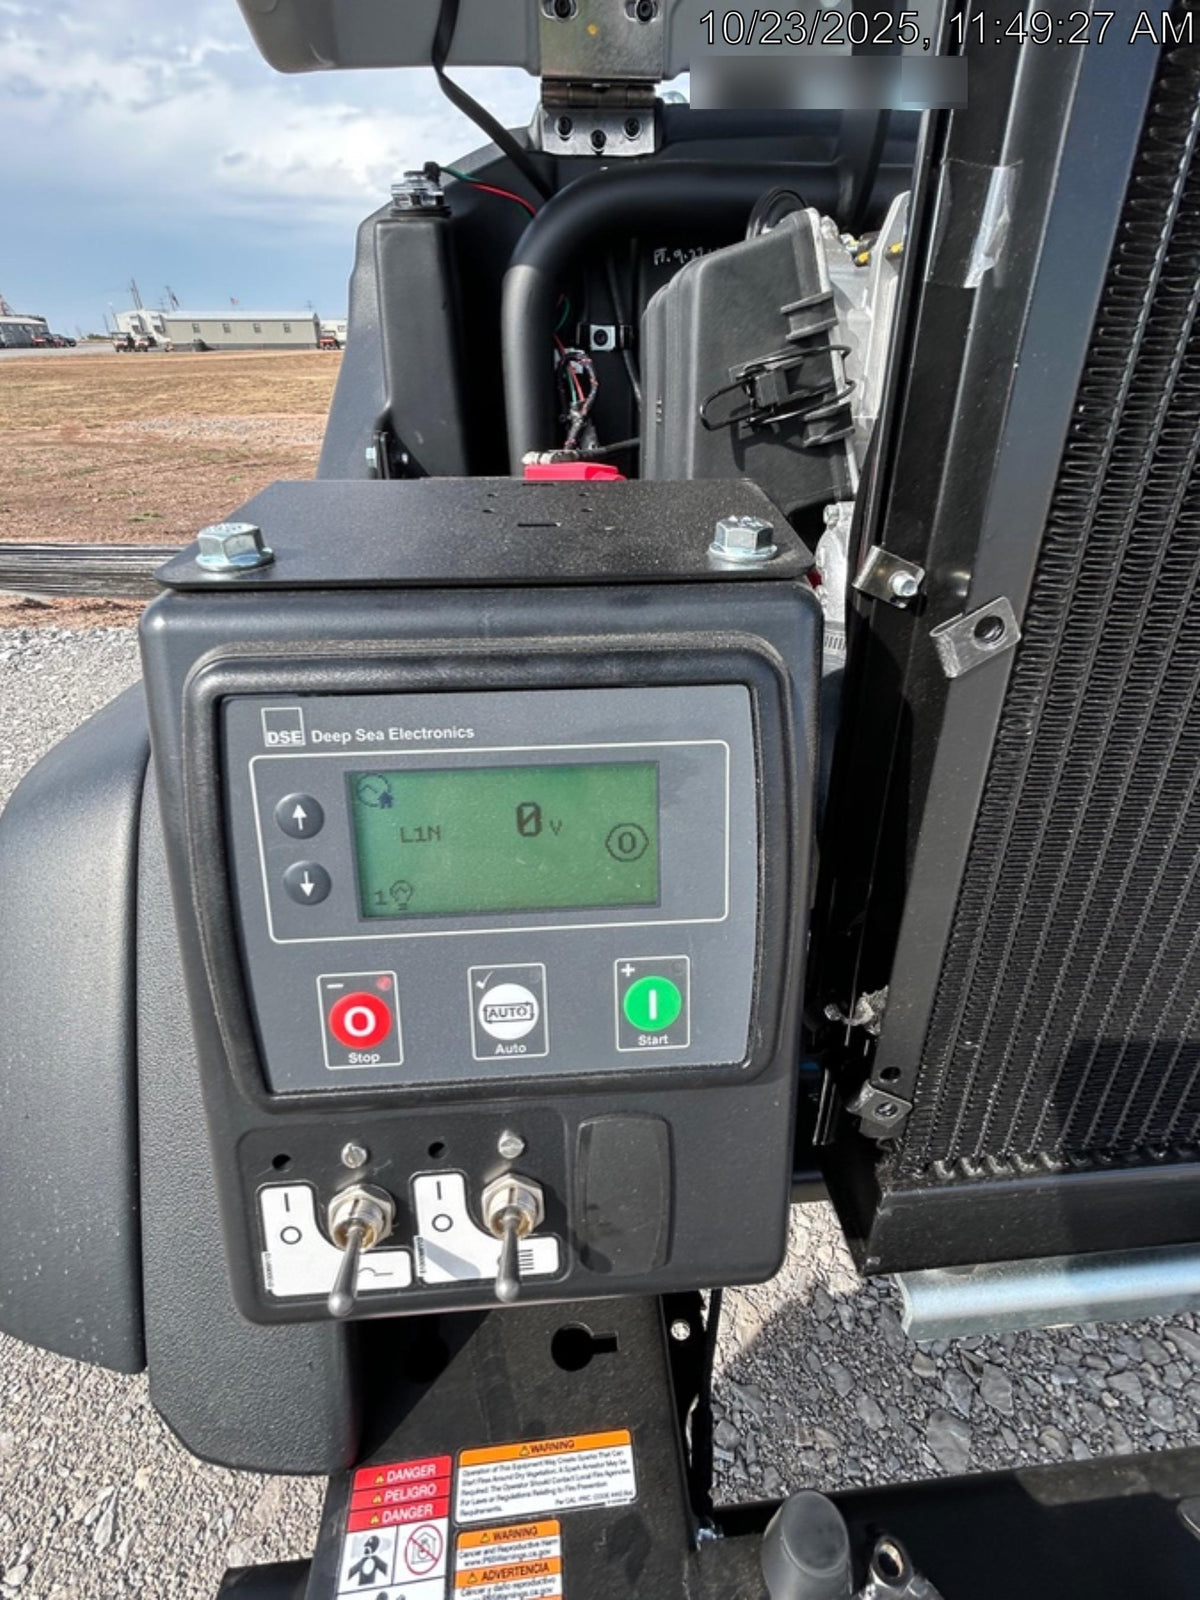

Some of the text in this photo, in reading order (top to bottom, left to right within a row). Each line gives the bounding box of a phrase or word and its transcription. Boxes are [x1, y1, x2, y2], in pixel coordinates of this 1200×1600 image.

[267, 726, 475, 745] DSE Deep Sea Electronics
[400, 825, 441, 843] L1N
[516, 802, 542, 837] 0
[488, 1006, 529, 1019] AUTO
[495, 1042, 527, 1055] Auto
[638, 1033, 669, 1046] Start
[348, 1052, 380, 1066] Stop
[530, 1440, 575, 1453] WARNING
[387, 1464, 436, 1482] DANGER
[384, 1483, 437, 1501] PELIGRO
[382, 1503, 434, 1522] DANGER
[493, 1525, 538, 1541] WARNING
[459, 1550, 481, 1559] Cancer
[484, 1547, 496, 1555] and
[497, 1541, 540, 1553] Reproductive
[482, 1562, 550, 1581] ADVERTENCIA
